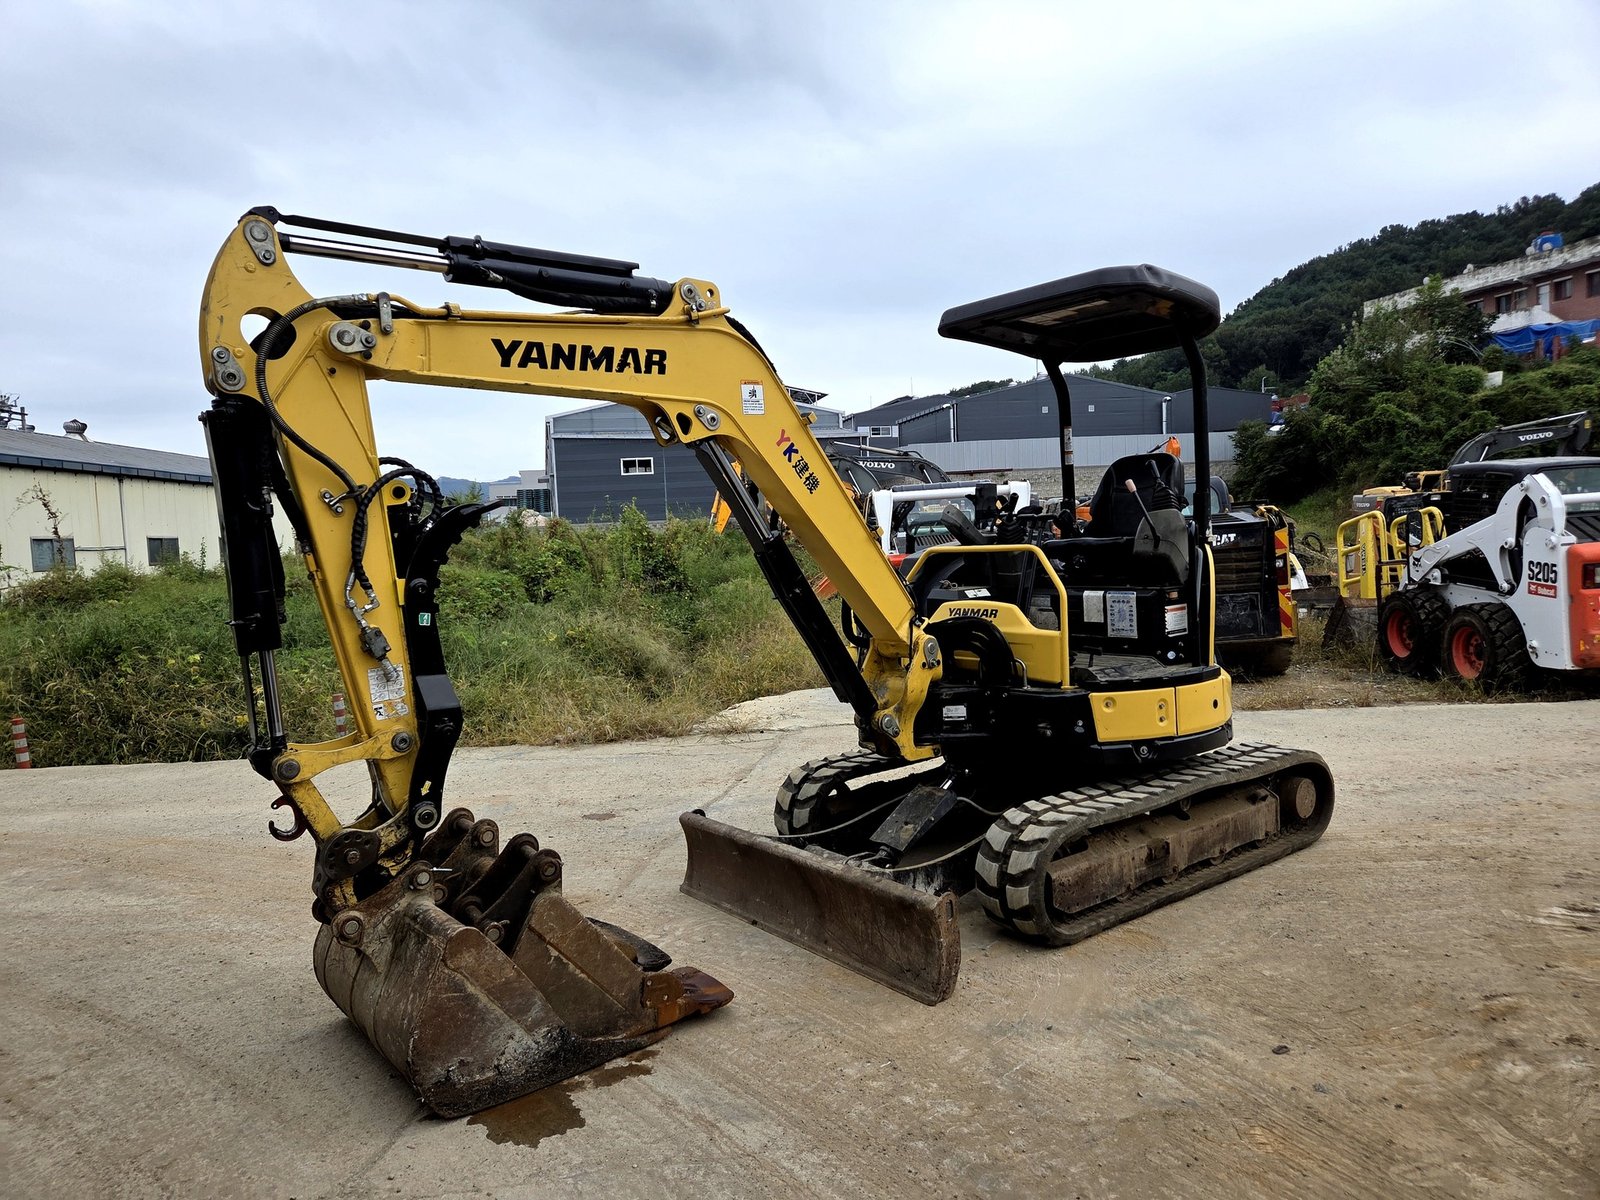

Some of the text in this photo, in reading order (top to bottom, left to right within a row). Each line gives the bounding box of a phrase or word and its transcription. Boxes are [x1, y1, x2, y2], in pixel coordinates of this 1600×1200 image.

[490, 338, 668, 375] YANMAR
[1518, 431, 1554, 442] VOLVO
[858, 460, 896, 469] VOLVO
[1527, 560, 1558, 584] S205
[948, 607, 999, 619] YANMAR
